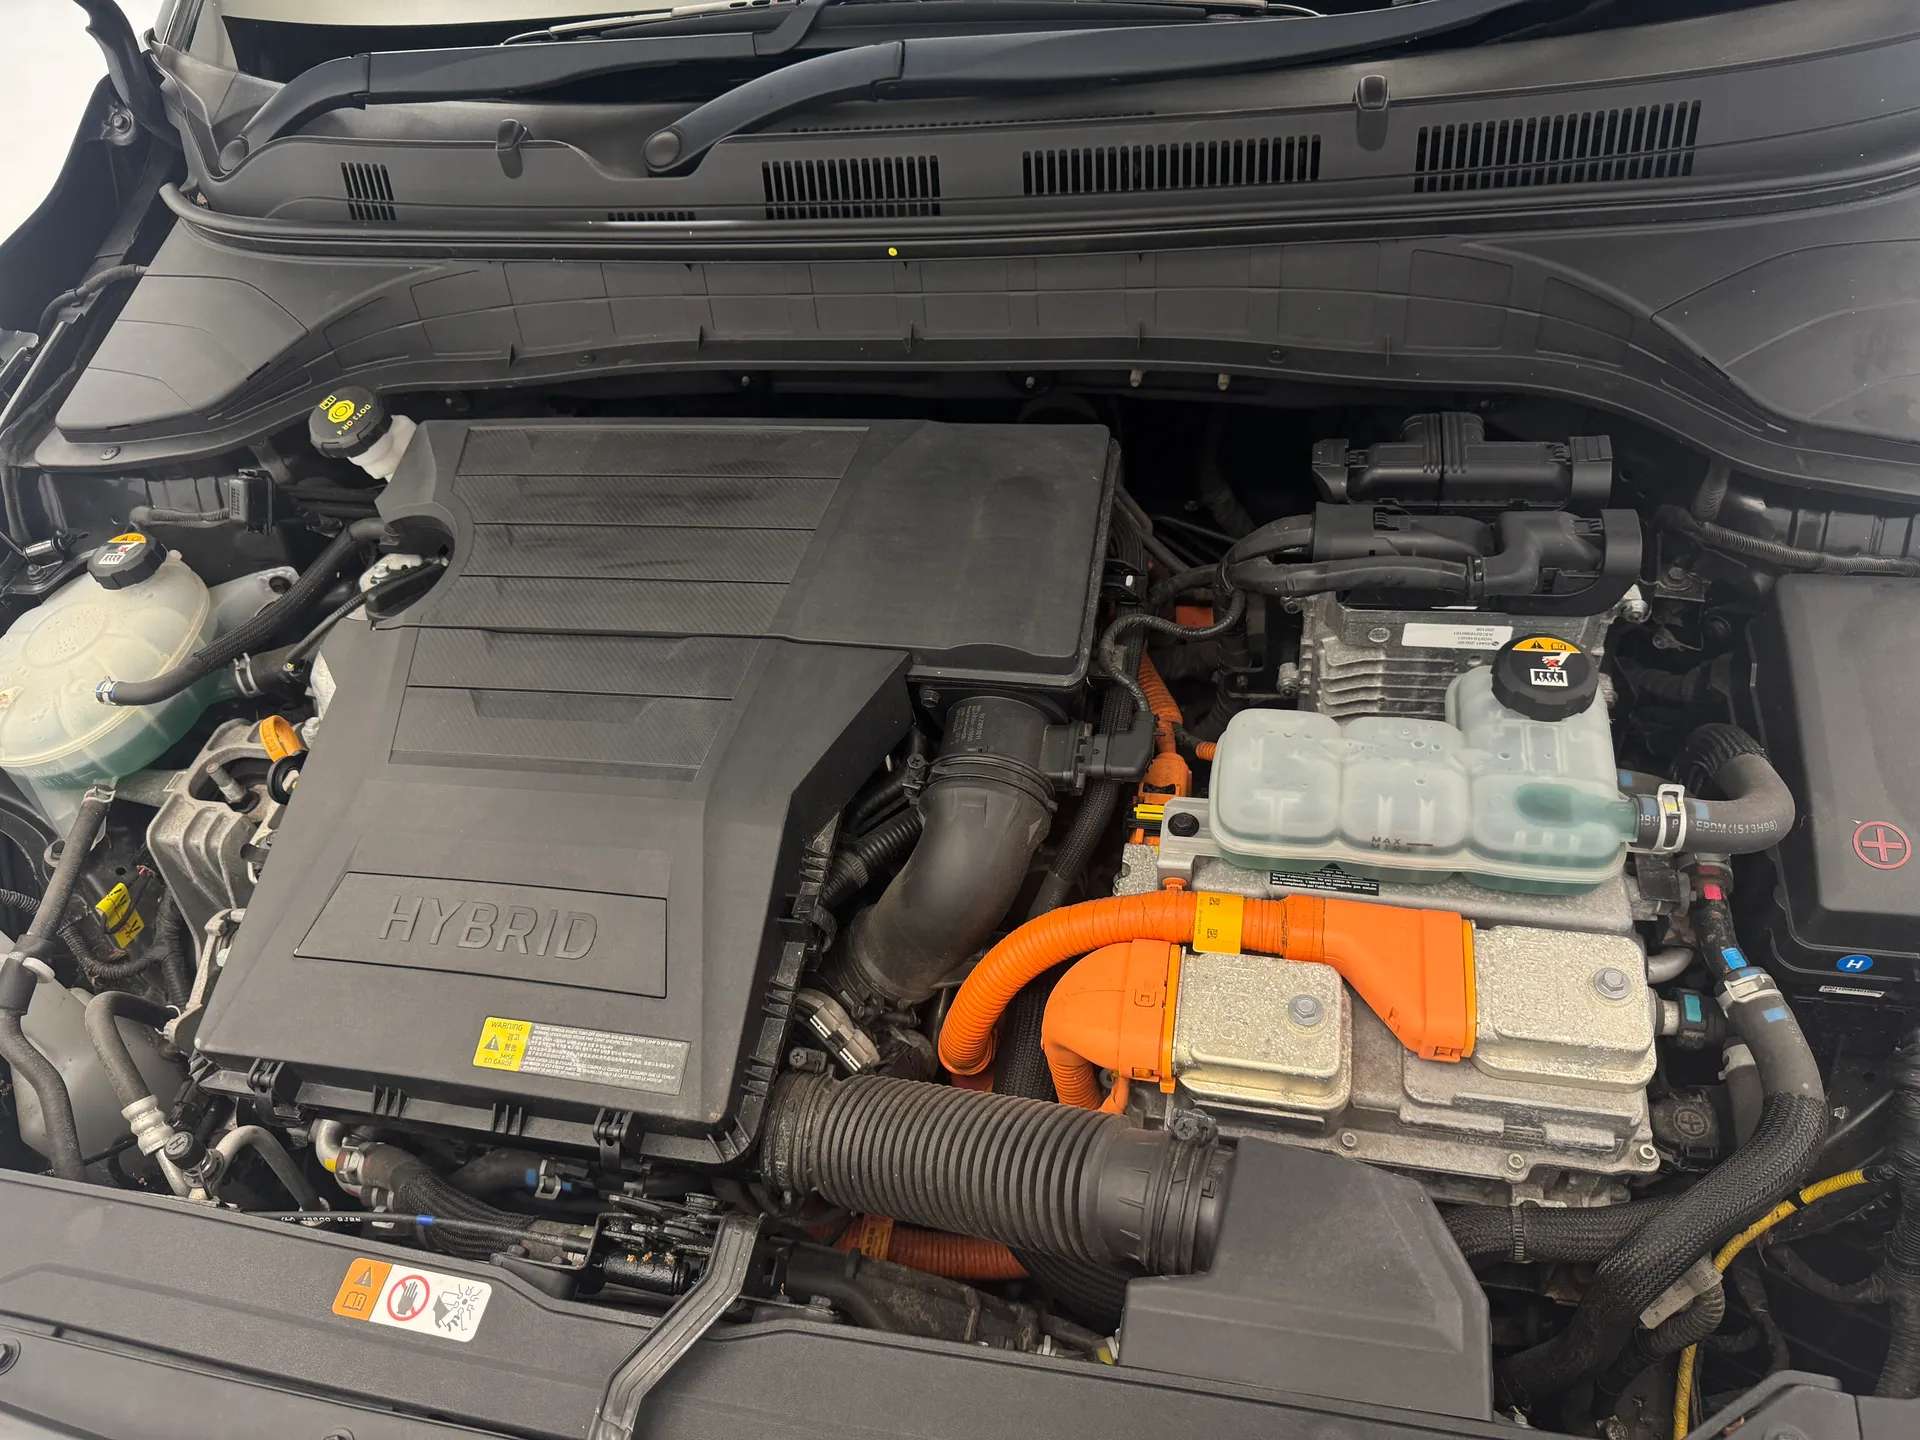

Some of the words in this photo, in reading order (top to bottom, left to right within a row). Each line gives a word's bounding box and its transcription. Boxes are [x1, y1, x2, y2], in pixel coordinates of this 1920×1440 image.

[352, 403, 372, 421] DOT3
[341, 419, 354, 431] OR
[1371, 835, 1401, 845] MAX
[376, 895, 598, 960] HYBRID
[1846, 959, 1865, 969] H
[490, 1020, 524, 1032] WARNING
